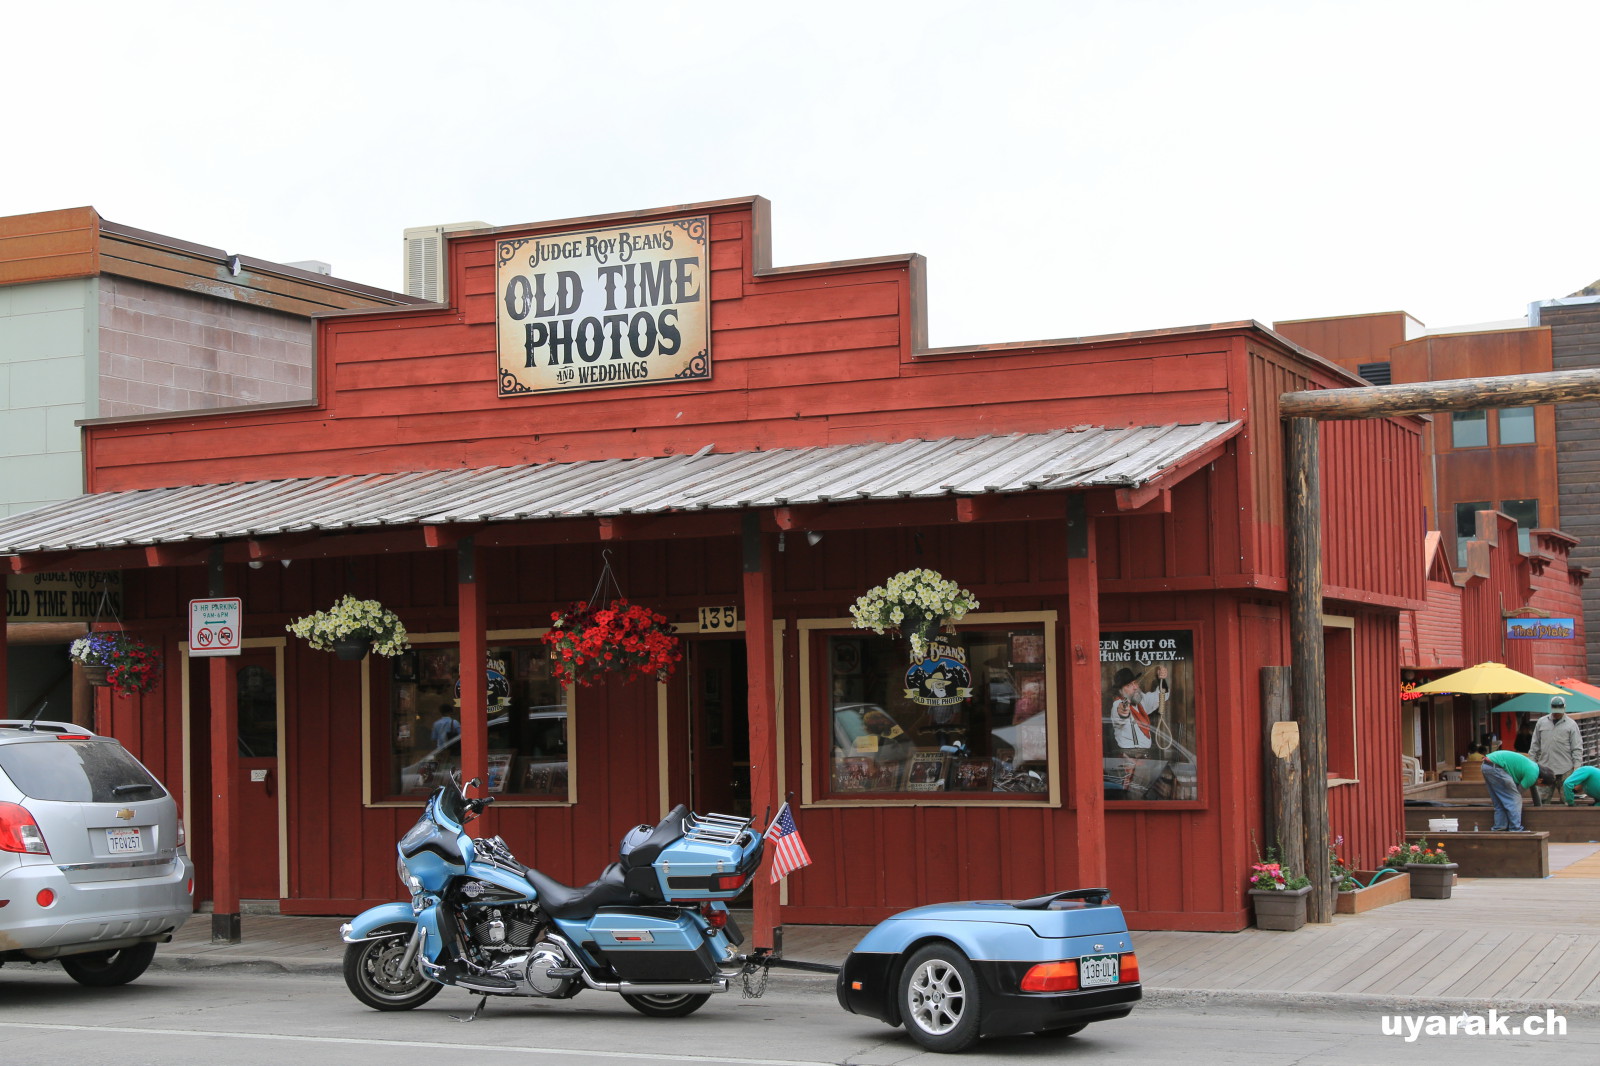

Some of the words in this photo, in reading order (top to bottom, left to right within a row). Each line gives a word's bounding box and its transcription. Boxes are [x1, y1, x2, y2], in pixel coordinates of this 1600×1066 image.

[529, 240, 582, 268] JUDGE
[585, 236, 616, 264] ROY
[504, 270, 584, 320] OLD
[598, 256, 700, 311] TIME
[524, 308, 681, 368] PHOTOS
[557, 367, 574, 383] AND
[578, 360, 648, 384] WEDDINGS
[34, 590, 68, 616] TIME
[72, 590, 120, 616] PHOTOS
[701, 607, 735, 629] 135
[1511, 625, 1538, 637] Thai
[1538, 625, 1570, 639] Plate
[1099, 640, 1119, 650] EEN
[1123, 639, 1155, 651] SHOT
[1159, 639, 1177, 649] OR
[1100, 650, 1131, 662] HUNG
